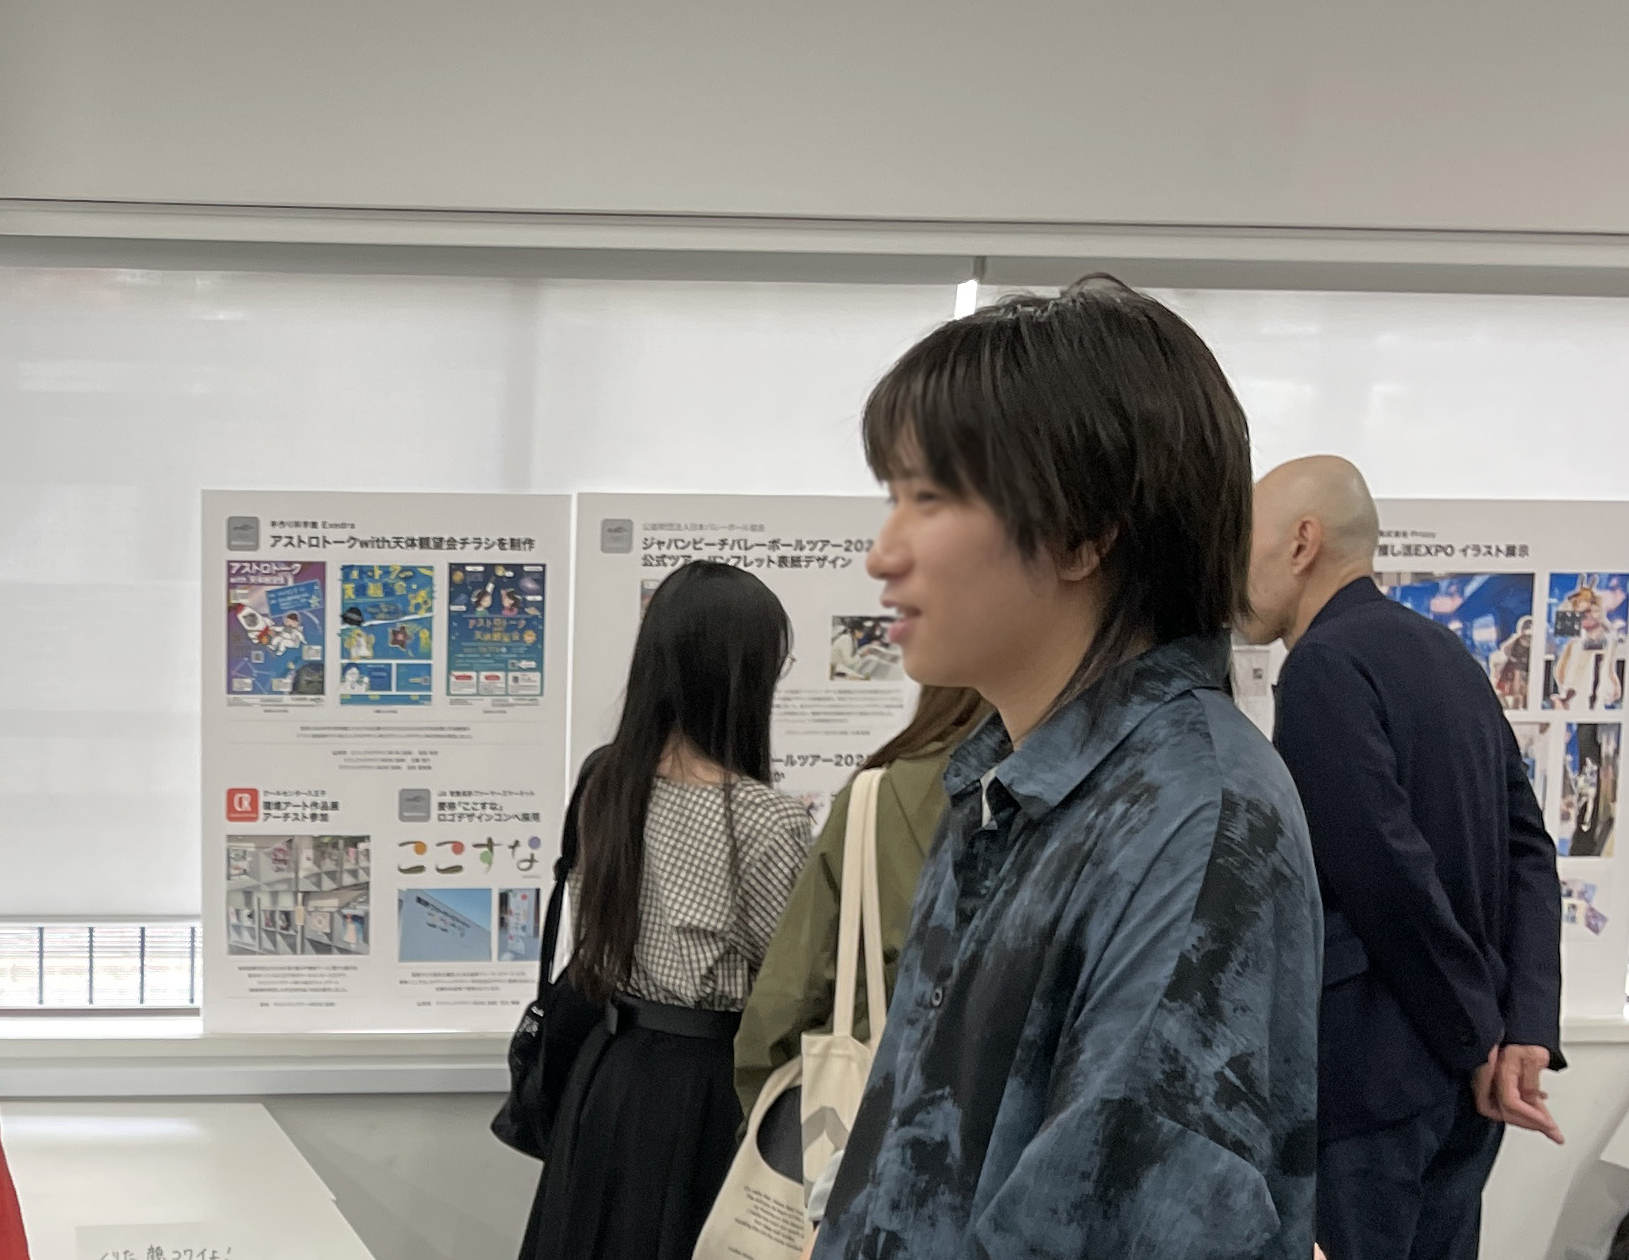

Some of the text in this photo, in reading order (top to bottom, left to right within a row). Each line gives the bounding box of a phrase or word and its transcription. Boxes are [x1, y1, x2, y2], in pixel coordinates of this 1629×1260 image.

[1459, 544, 1530, 557] イラスト展示
[772, 754, 870, 767] ールツアー202
